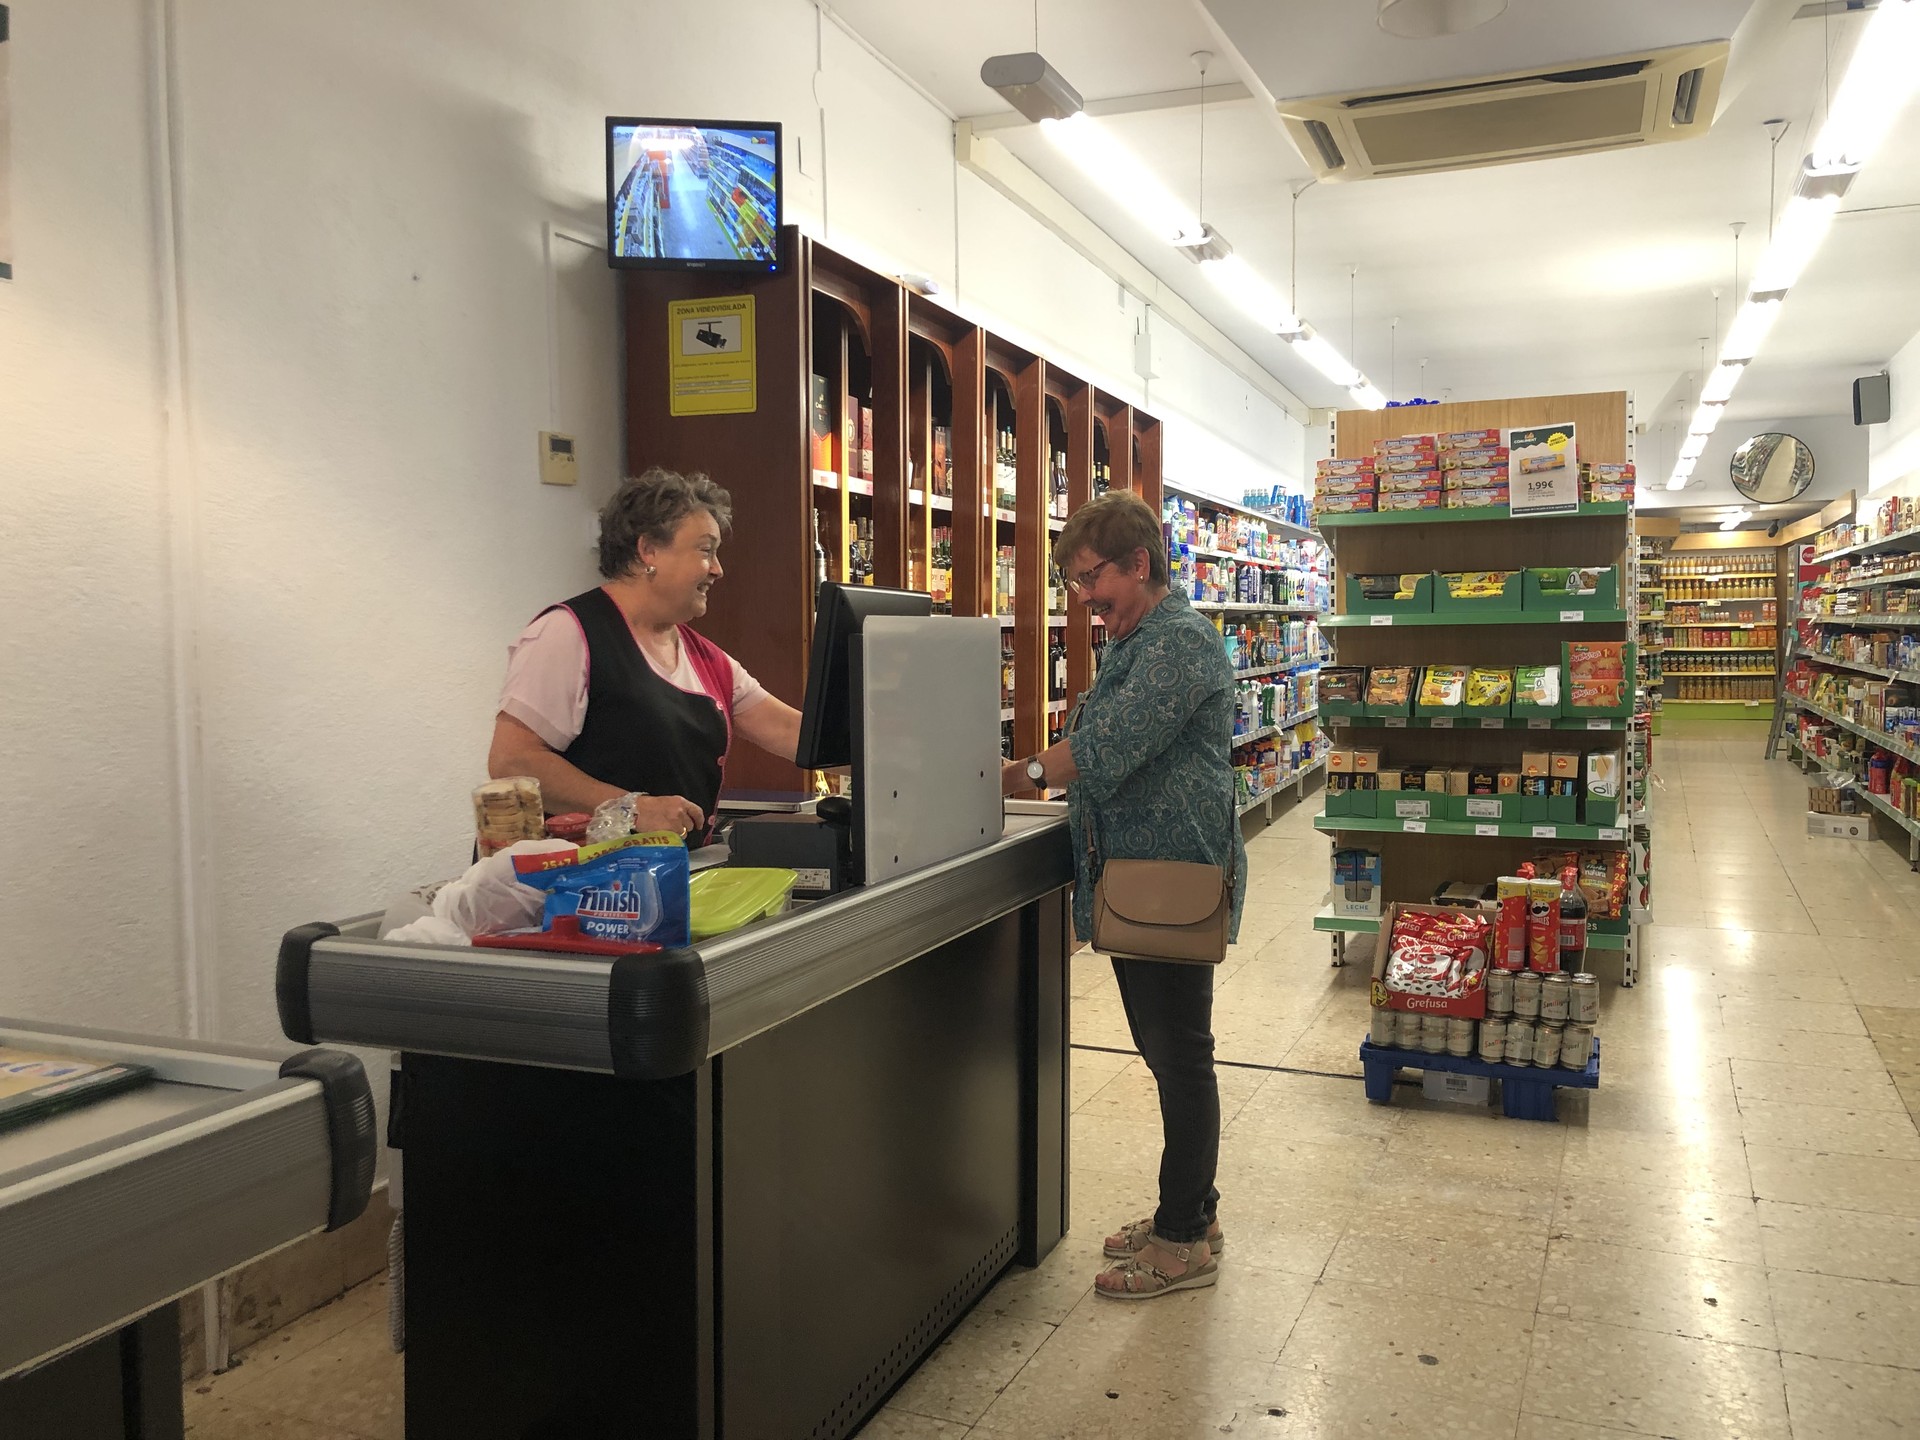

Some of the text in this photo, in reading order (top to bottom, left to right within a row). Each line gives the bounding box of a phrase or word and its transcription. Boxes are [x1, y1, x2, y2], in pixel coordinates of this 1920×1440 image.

[676, 303, 747, 315] ZONA VIDEOVIGILADA
[1528, 480, 1554, 490] 1,99€
[541, 858, 572, 870] 25+7
[580, 881, 640, 913] Finish
[586, 921, 630, 935] POWER
[1406, 997, 1448, 1009] Grefusa
